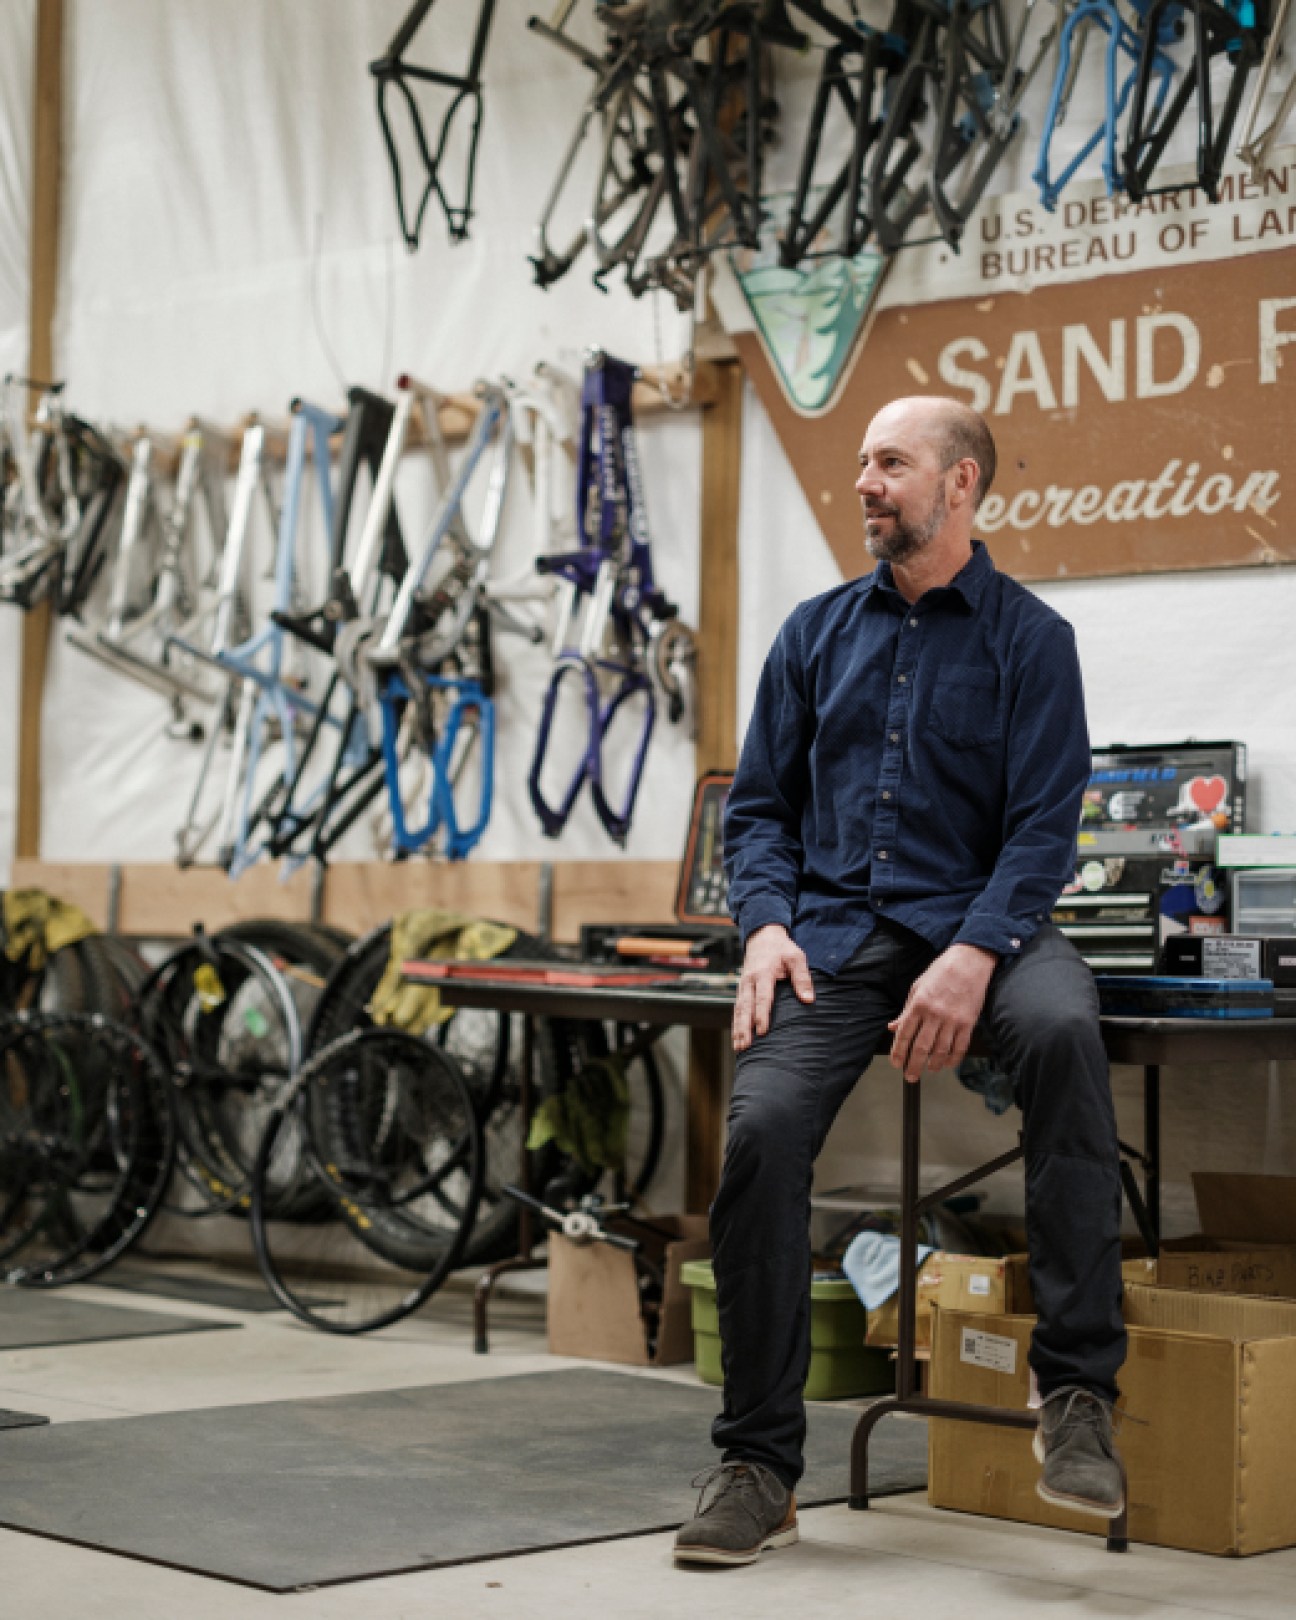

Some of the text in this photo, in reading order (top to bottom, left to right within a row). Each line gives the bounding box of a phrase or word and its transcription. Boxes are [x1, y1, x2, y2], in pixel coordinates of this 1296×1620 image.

[980, 163, 1296, 243] U.S. DEPARTMEN
[980, 231, 1137, 279] BUREAU
[1158, 218, 1209, 252] OF
[938, 310, 1201, 416] SAND
[973, 457, 1280, 533] ecreation
